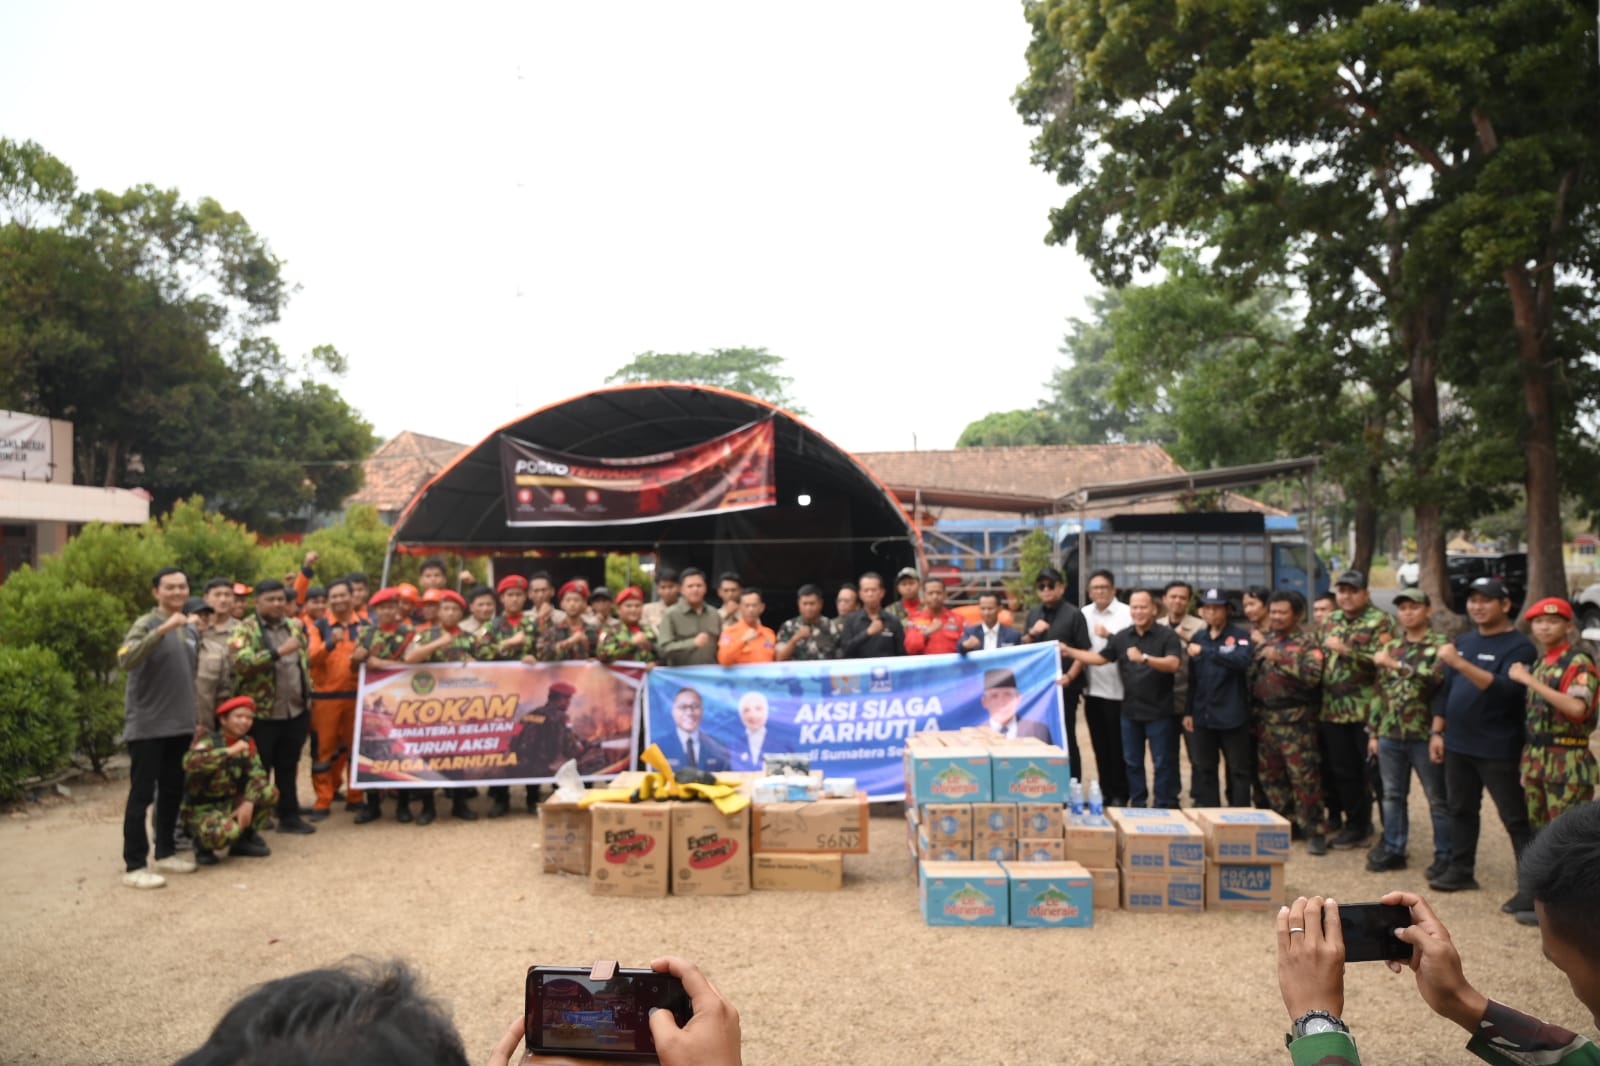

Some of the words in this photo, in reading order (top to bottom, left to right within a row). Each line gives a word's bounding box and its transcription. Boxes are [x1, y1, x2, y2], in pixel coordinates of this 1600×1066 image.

[394, 695, 519, 726] KOKAM
[794, 701, 857, 723] AKSI
[861, 696, 943, 719] SIAGA
[389, 724, 456, 738] SUMATERA
[458, 722, 515, 735] SELATAN
[403, 740, 458, 755] TURUN
[460, 737, 500, 752] AKSI
[821, 747, 885, 761] Sumatera
[370, 758, 425, 774] SIAGA
[429, 752, 518, 771] KARHUTLA
[960, 894, 976, 905] Le
[1045, 894, 1060, 905] Le
[944, 904, 995, 916] Minerale
[1028, 905, 1079, 917] Minerale
